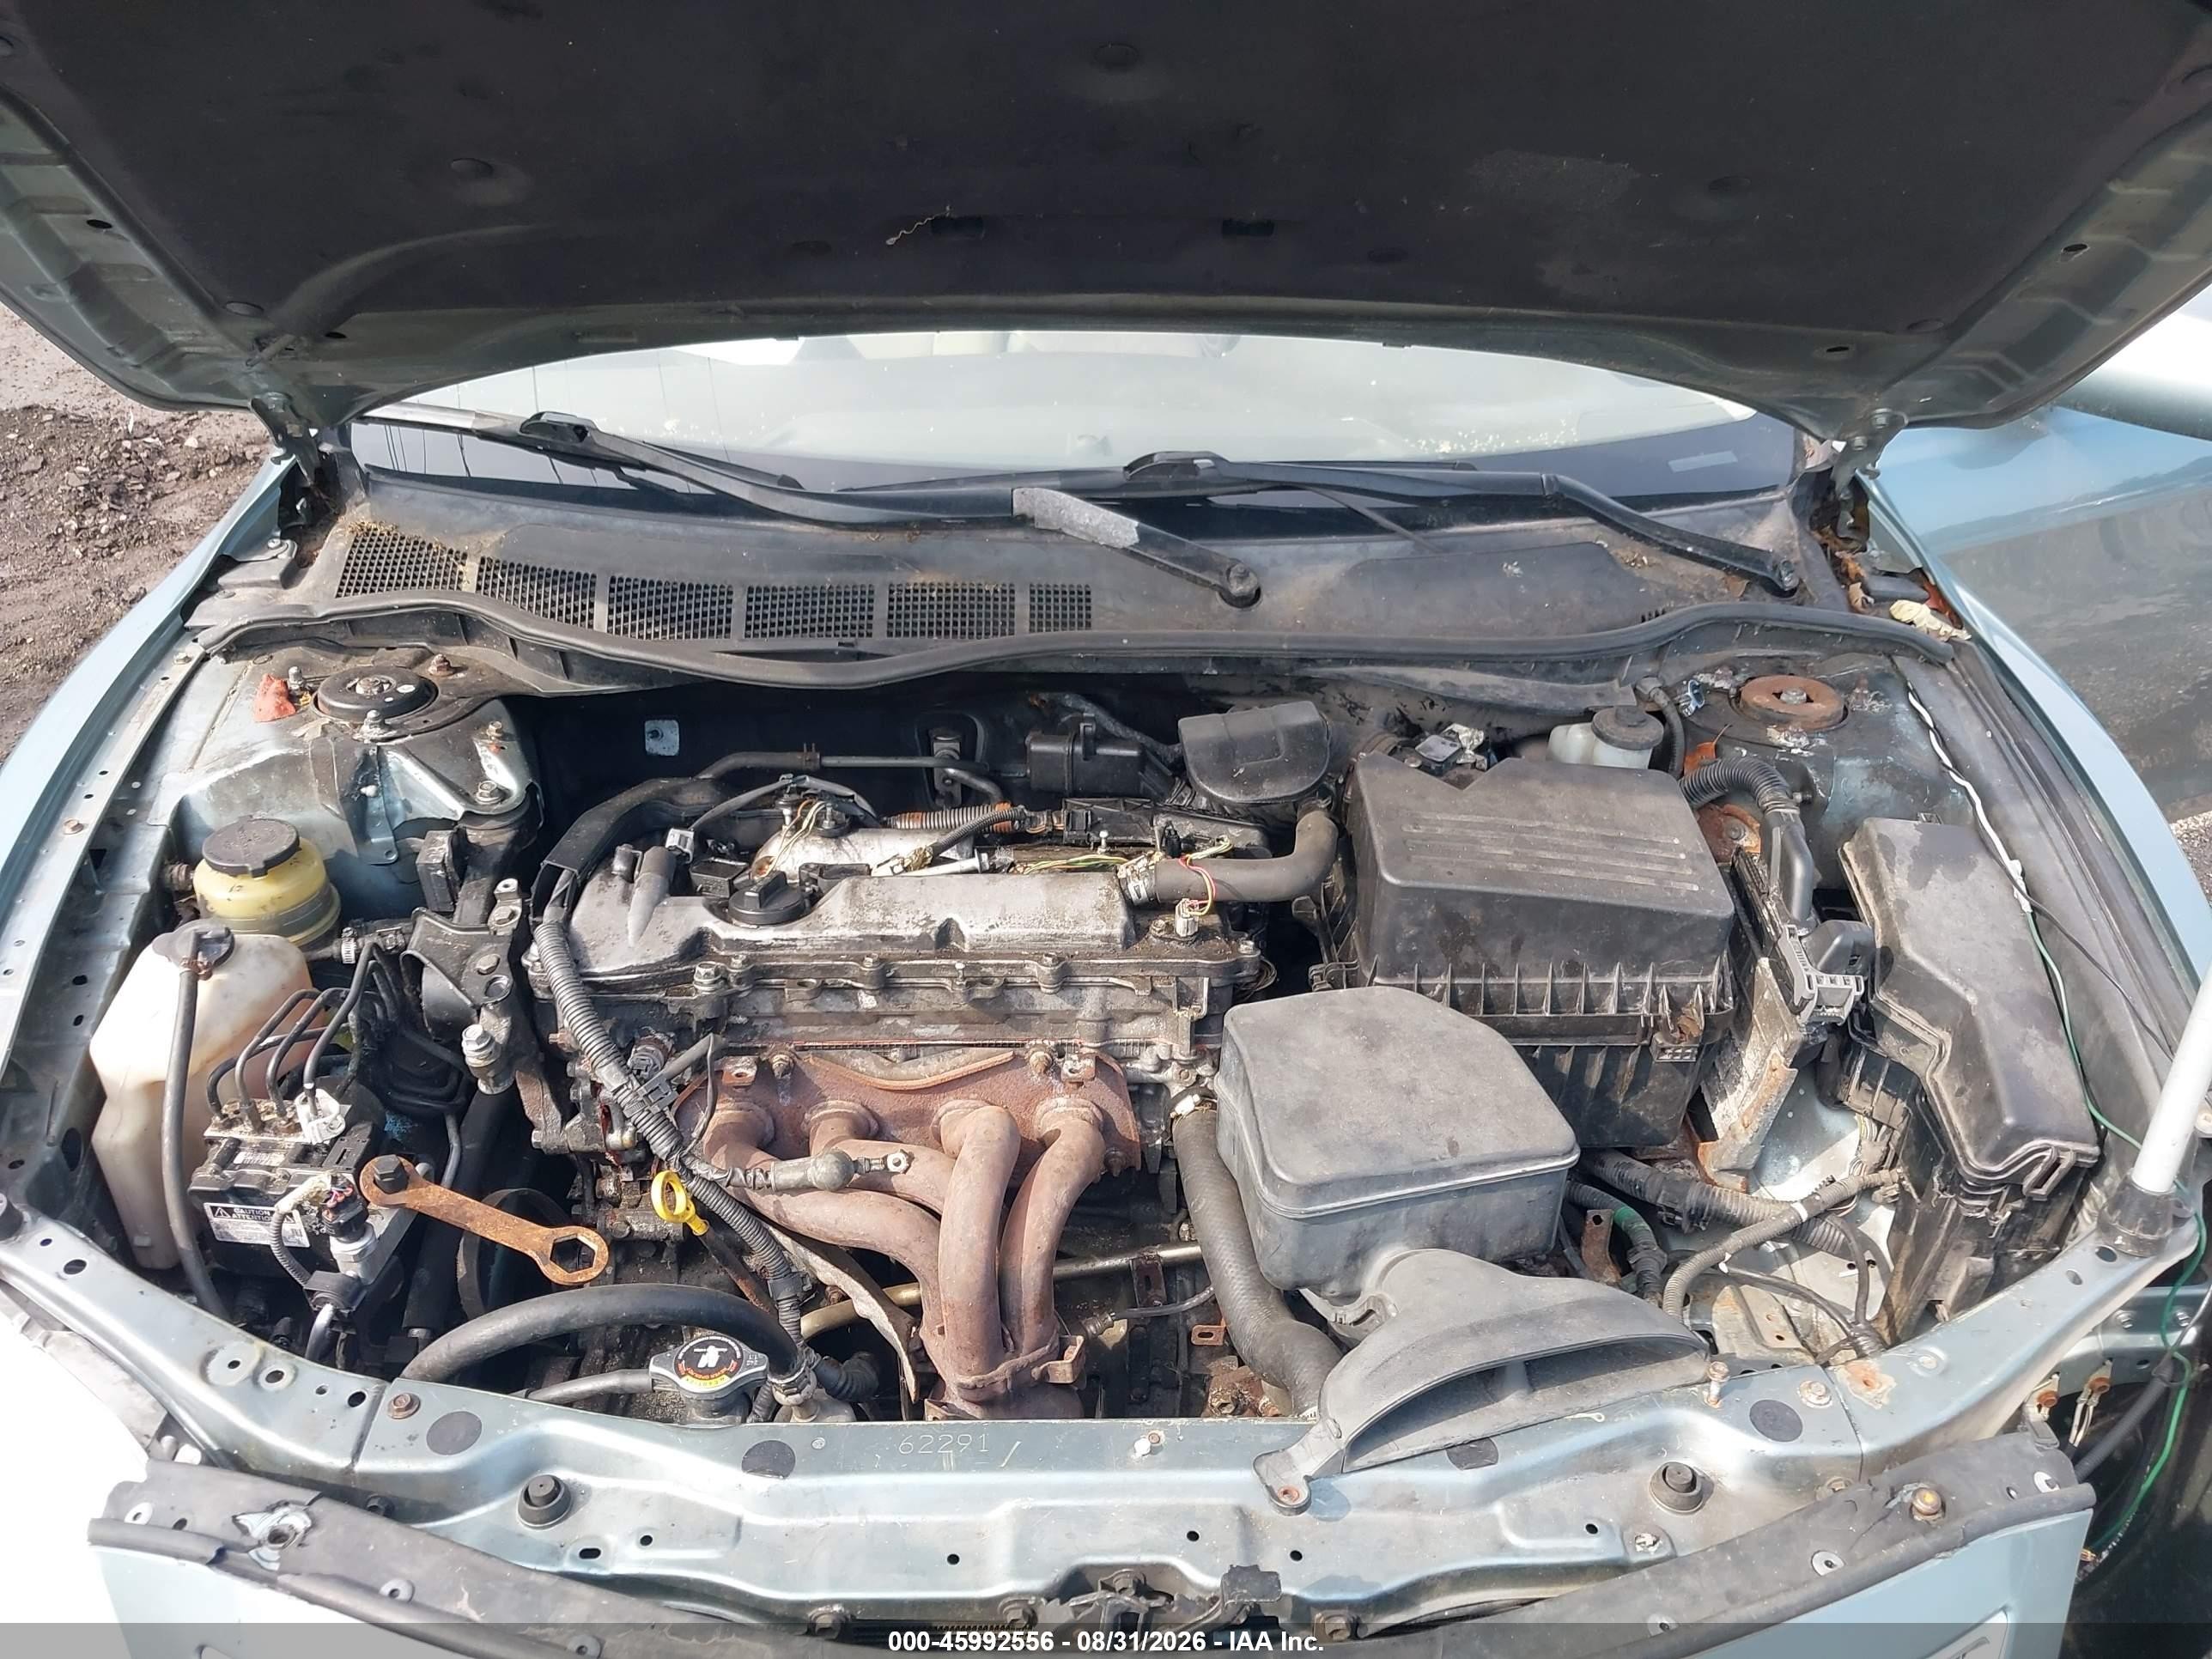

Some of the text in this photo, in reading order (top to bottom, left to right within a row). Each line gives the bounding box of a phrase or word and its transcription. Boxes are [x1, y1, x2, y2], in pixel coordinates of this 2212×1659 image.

[232, 1212, 272, 1221] ATTENTIO
[234, 1208, 271, 1217] CAUTION
[898, 1434, 989, 1455] 62291
